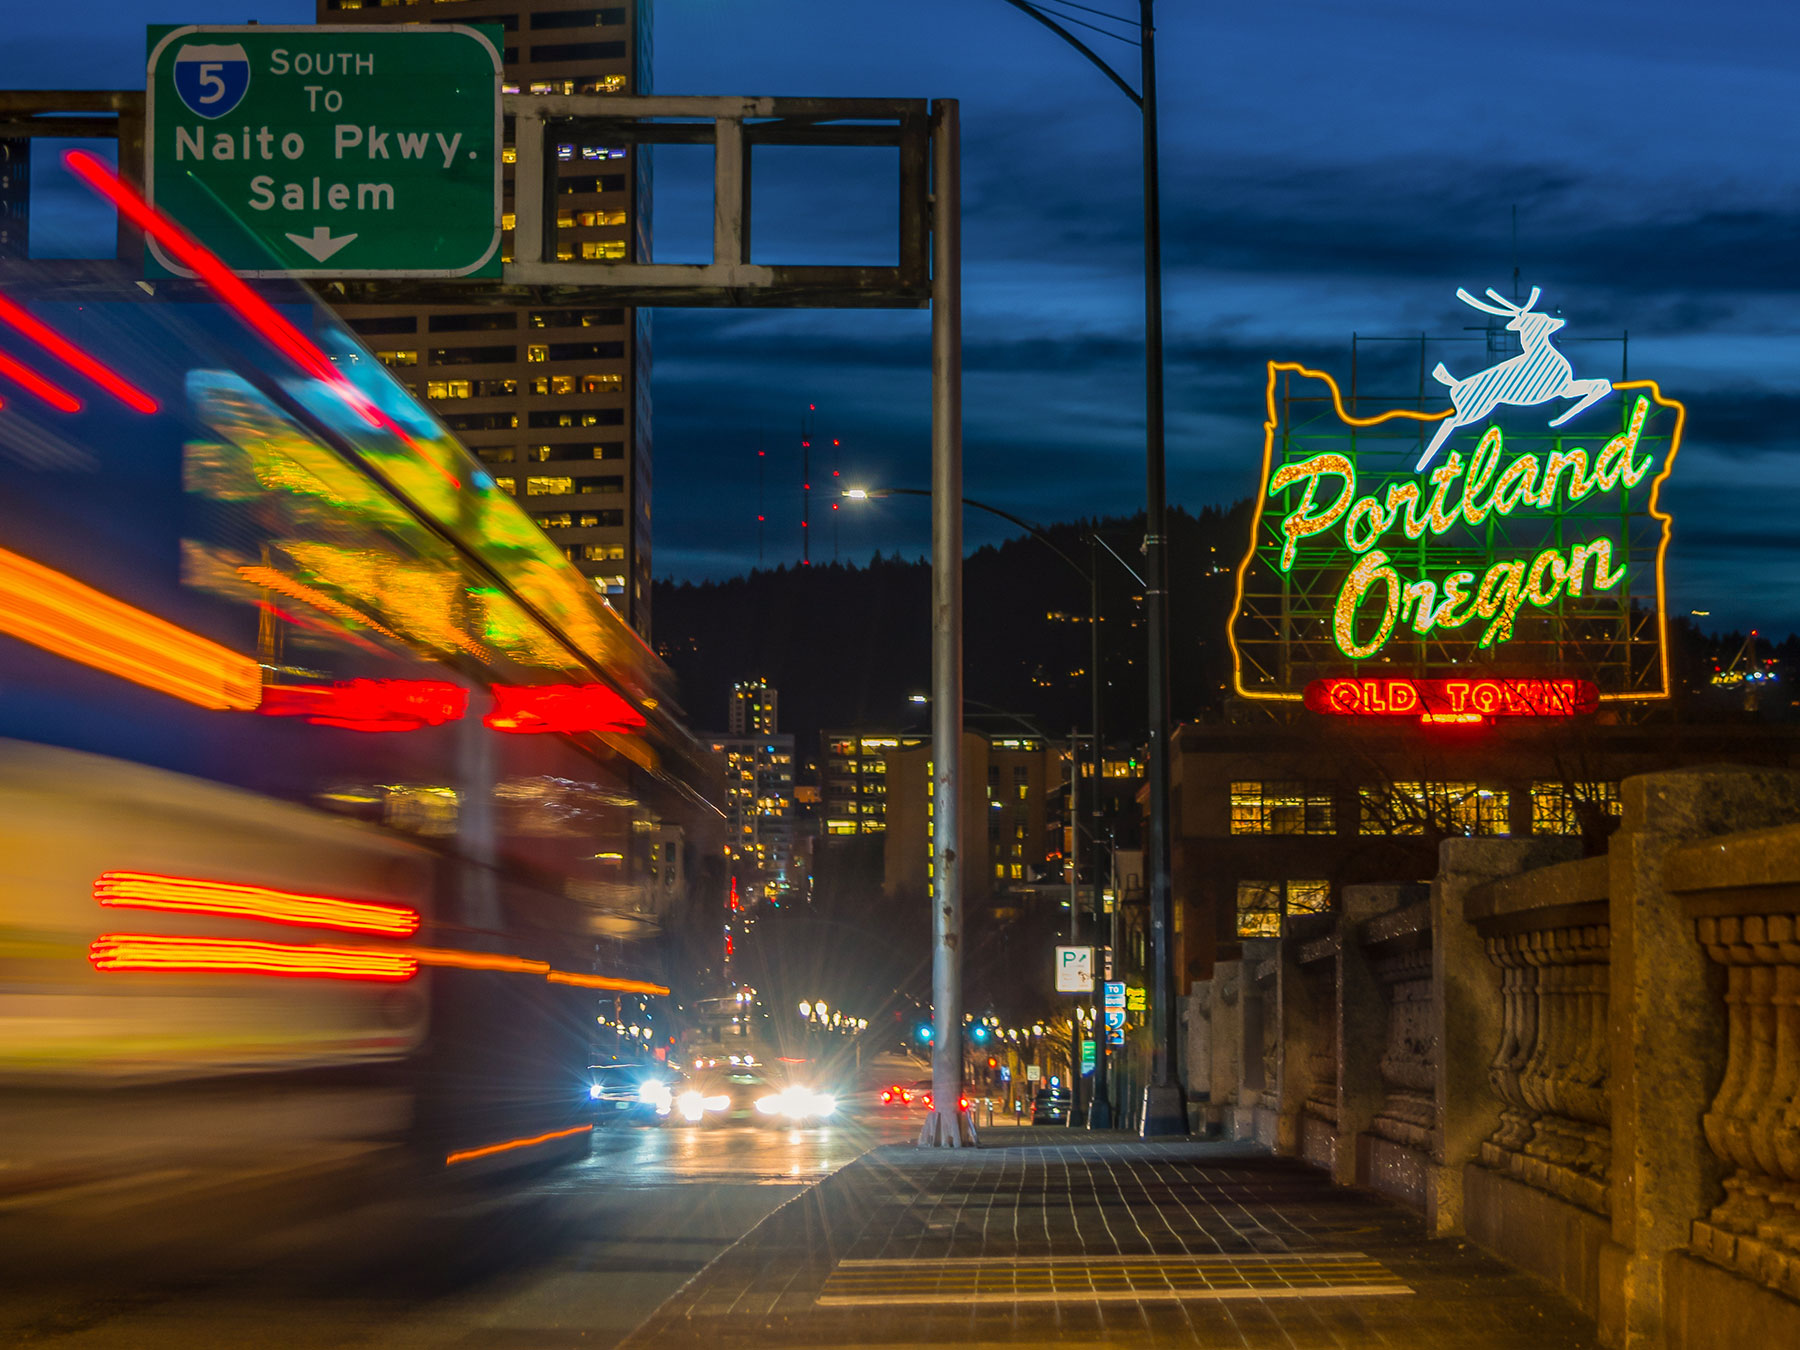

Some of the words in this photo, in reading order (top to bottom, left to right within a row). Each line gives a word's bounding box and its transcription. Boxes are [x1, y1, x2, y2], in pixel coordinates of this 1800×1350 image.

[269, 48, 374, 76] SOUTH
[199, 63, 226, 104] 5
[175, 125, 305, 161] Naito
[335, 124, 478, 169] Pkwy.
[248, 175, 395, 211] Salem
[1268, 394, 1654, 572] Portland
[1333, 536, 1628, 660] Oregon
[1330, 682, 1417, 712] OLD
[1446, 682, 1574, 713] TOWN
[1063, 951, 1077, 968] P
[1108, 986, 1120, 994] TO
[1109, 1013, 1119, 1026] 5
